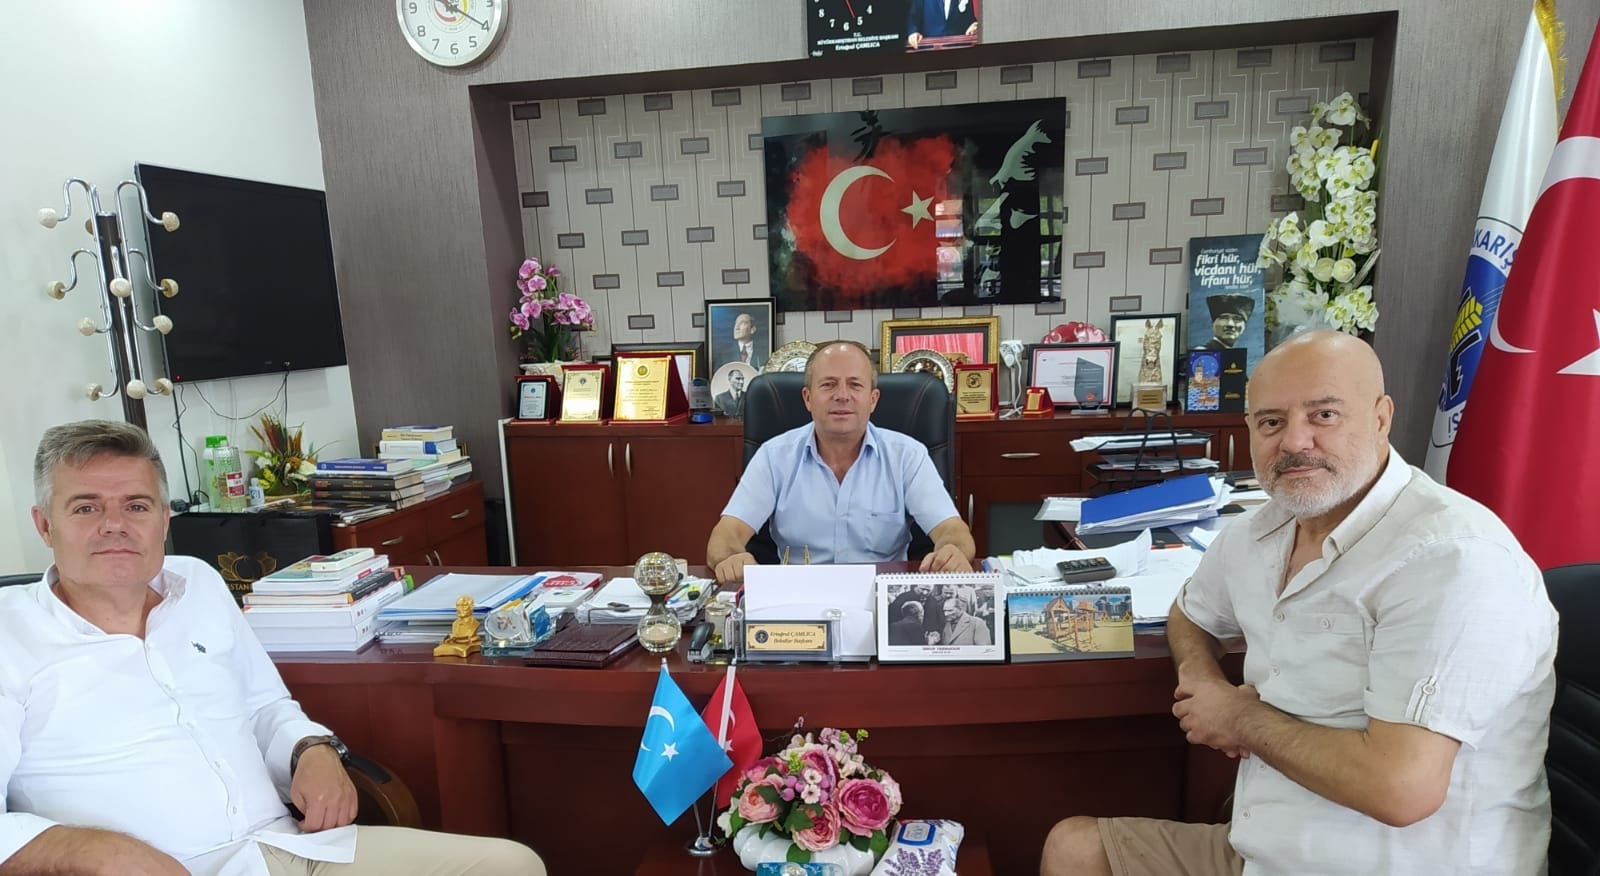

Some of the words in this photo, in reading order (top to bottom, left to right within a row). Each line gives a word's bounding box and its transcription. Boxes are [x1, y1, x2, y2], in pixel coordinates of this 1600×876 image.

[408, 2, 418, 14] 9
[818, 8, 825, 18] 8
[866, 4, 873, 15] 4
[481, 20, 490, 33] 4
[829, 18, 836, 28] 7
[843, 22, 850, 32] 6
[856, 16, 863, 26] 5
[416, 25, 426, 37] 8
[432, 38, 440, 51] 7
[468, 36, 478, 48] 5
[449, 43, 459, 55] 6
[1196, 254, 1219, 267] fikri
[1220, 253, 1240, 264] hür,
[1194, 264, 1236, 276] vicdanı
[1239, 262, 1262, 275] hür,
[1200, 275, 1230, 288] irfanı
[1232, 274, 1253, 285] hür,
